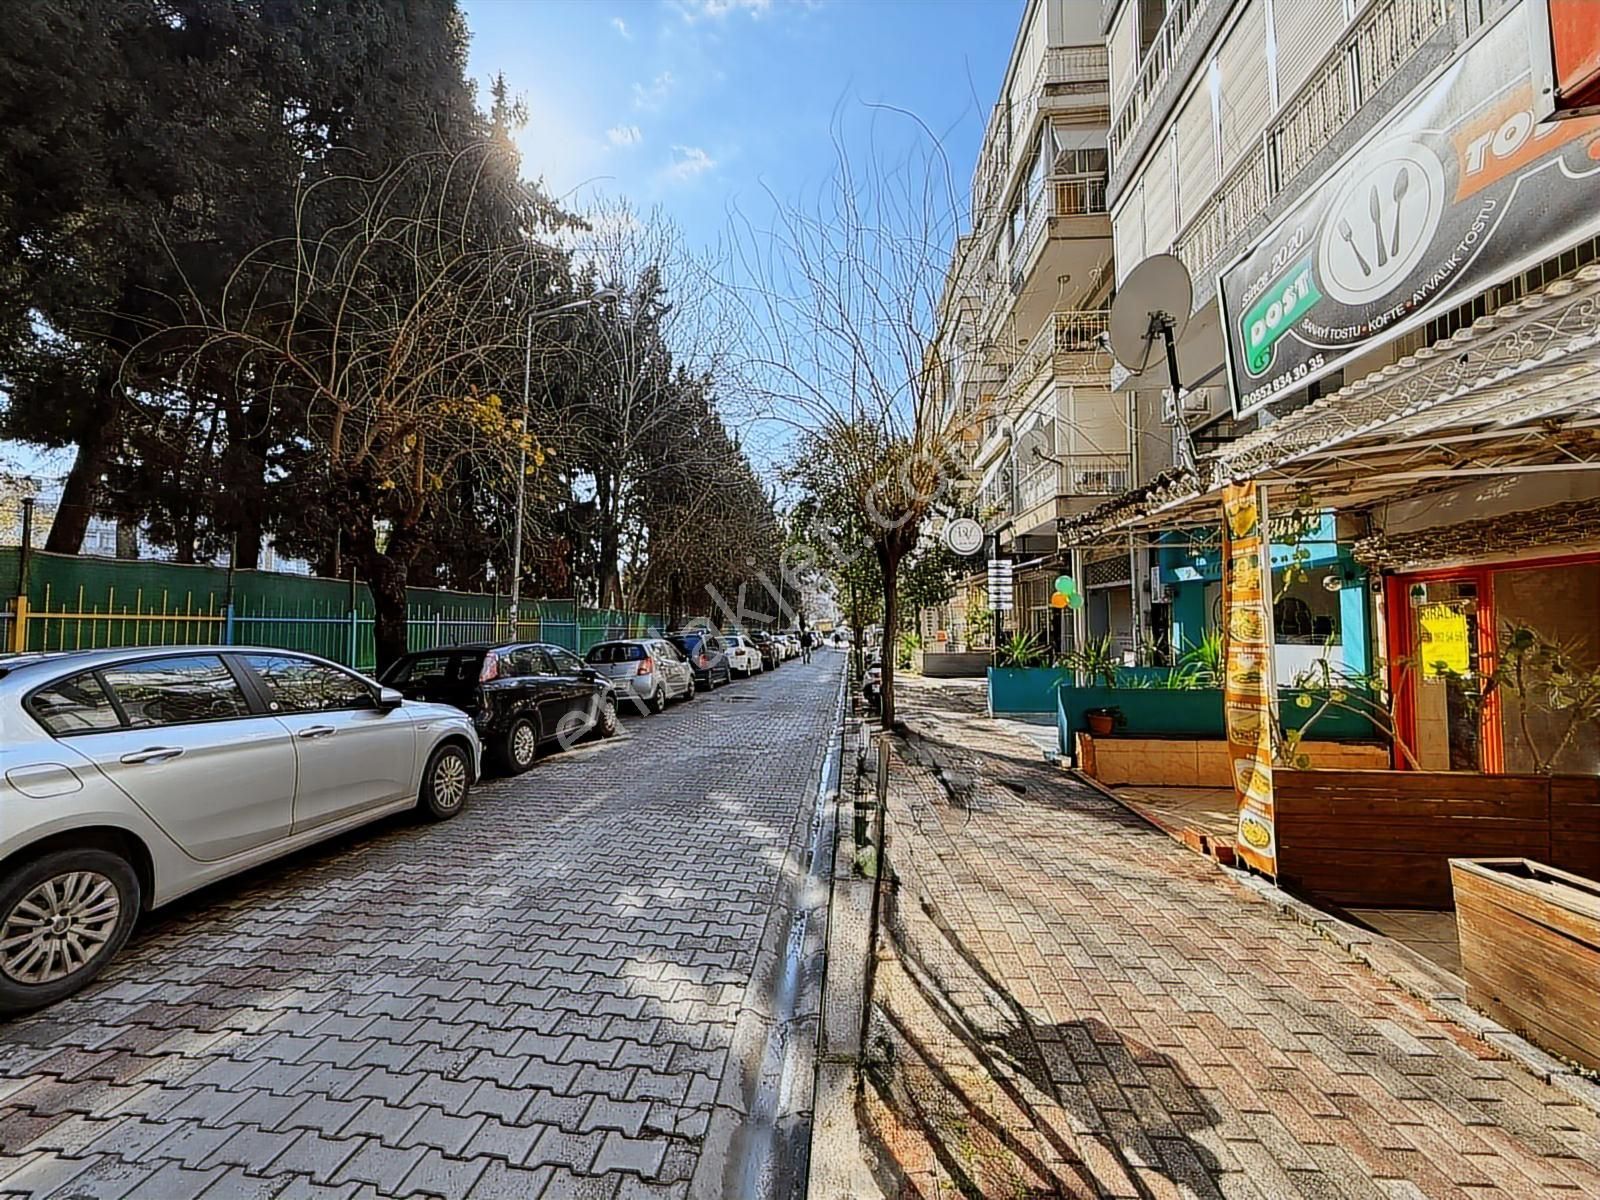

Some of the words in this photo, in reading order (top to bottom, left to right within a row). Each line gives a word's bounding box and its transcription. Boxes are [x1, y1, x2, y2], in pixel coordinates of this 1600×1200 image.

[1271, 227, 1304, 275] 2020
[1412, 253, 1462, 306] AYVALIK
[1457, 200, 1497, 253] TOSTU
[1251, 268, 1310, 347] DOST
[1309, 353, 1325, 372] 35
